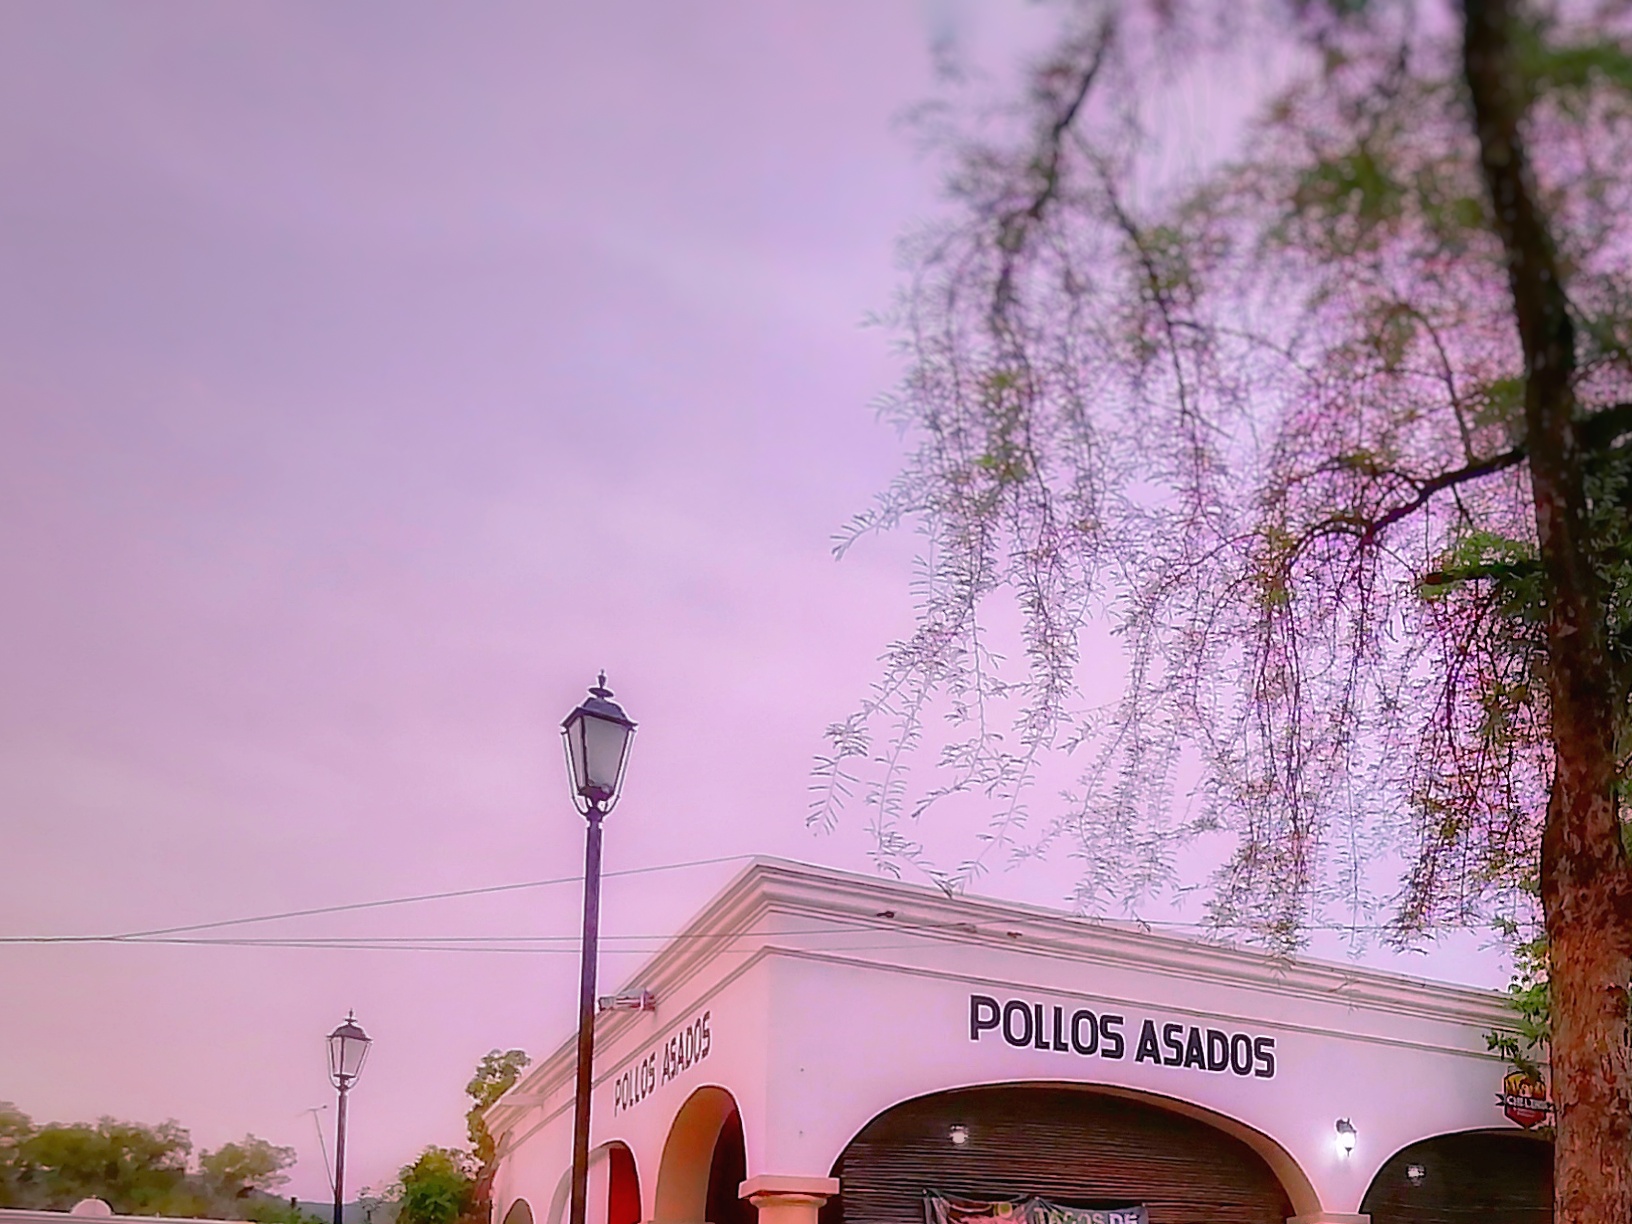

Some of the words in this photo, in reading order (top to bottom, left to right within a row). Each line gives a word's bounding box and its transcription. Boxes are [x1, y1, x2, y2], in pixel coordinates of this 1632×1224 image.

[614, 1051, 656, 1117] POLLOS
[661, 1010, 710, 1087] ASADOS
[970, 995, 1125, 1059] POLLOS
[1134, 1019, 1276, 1078] ASADOS
